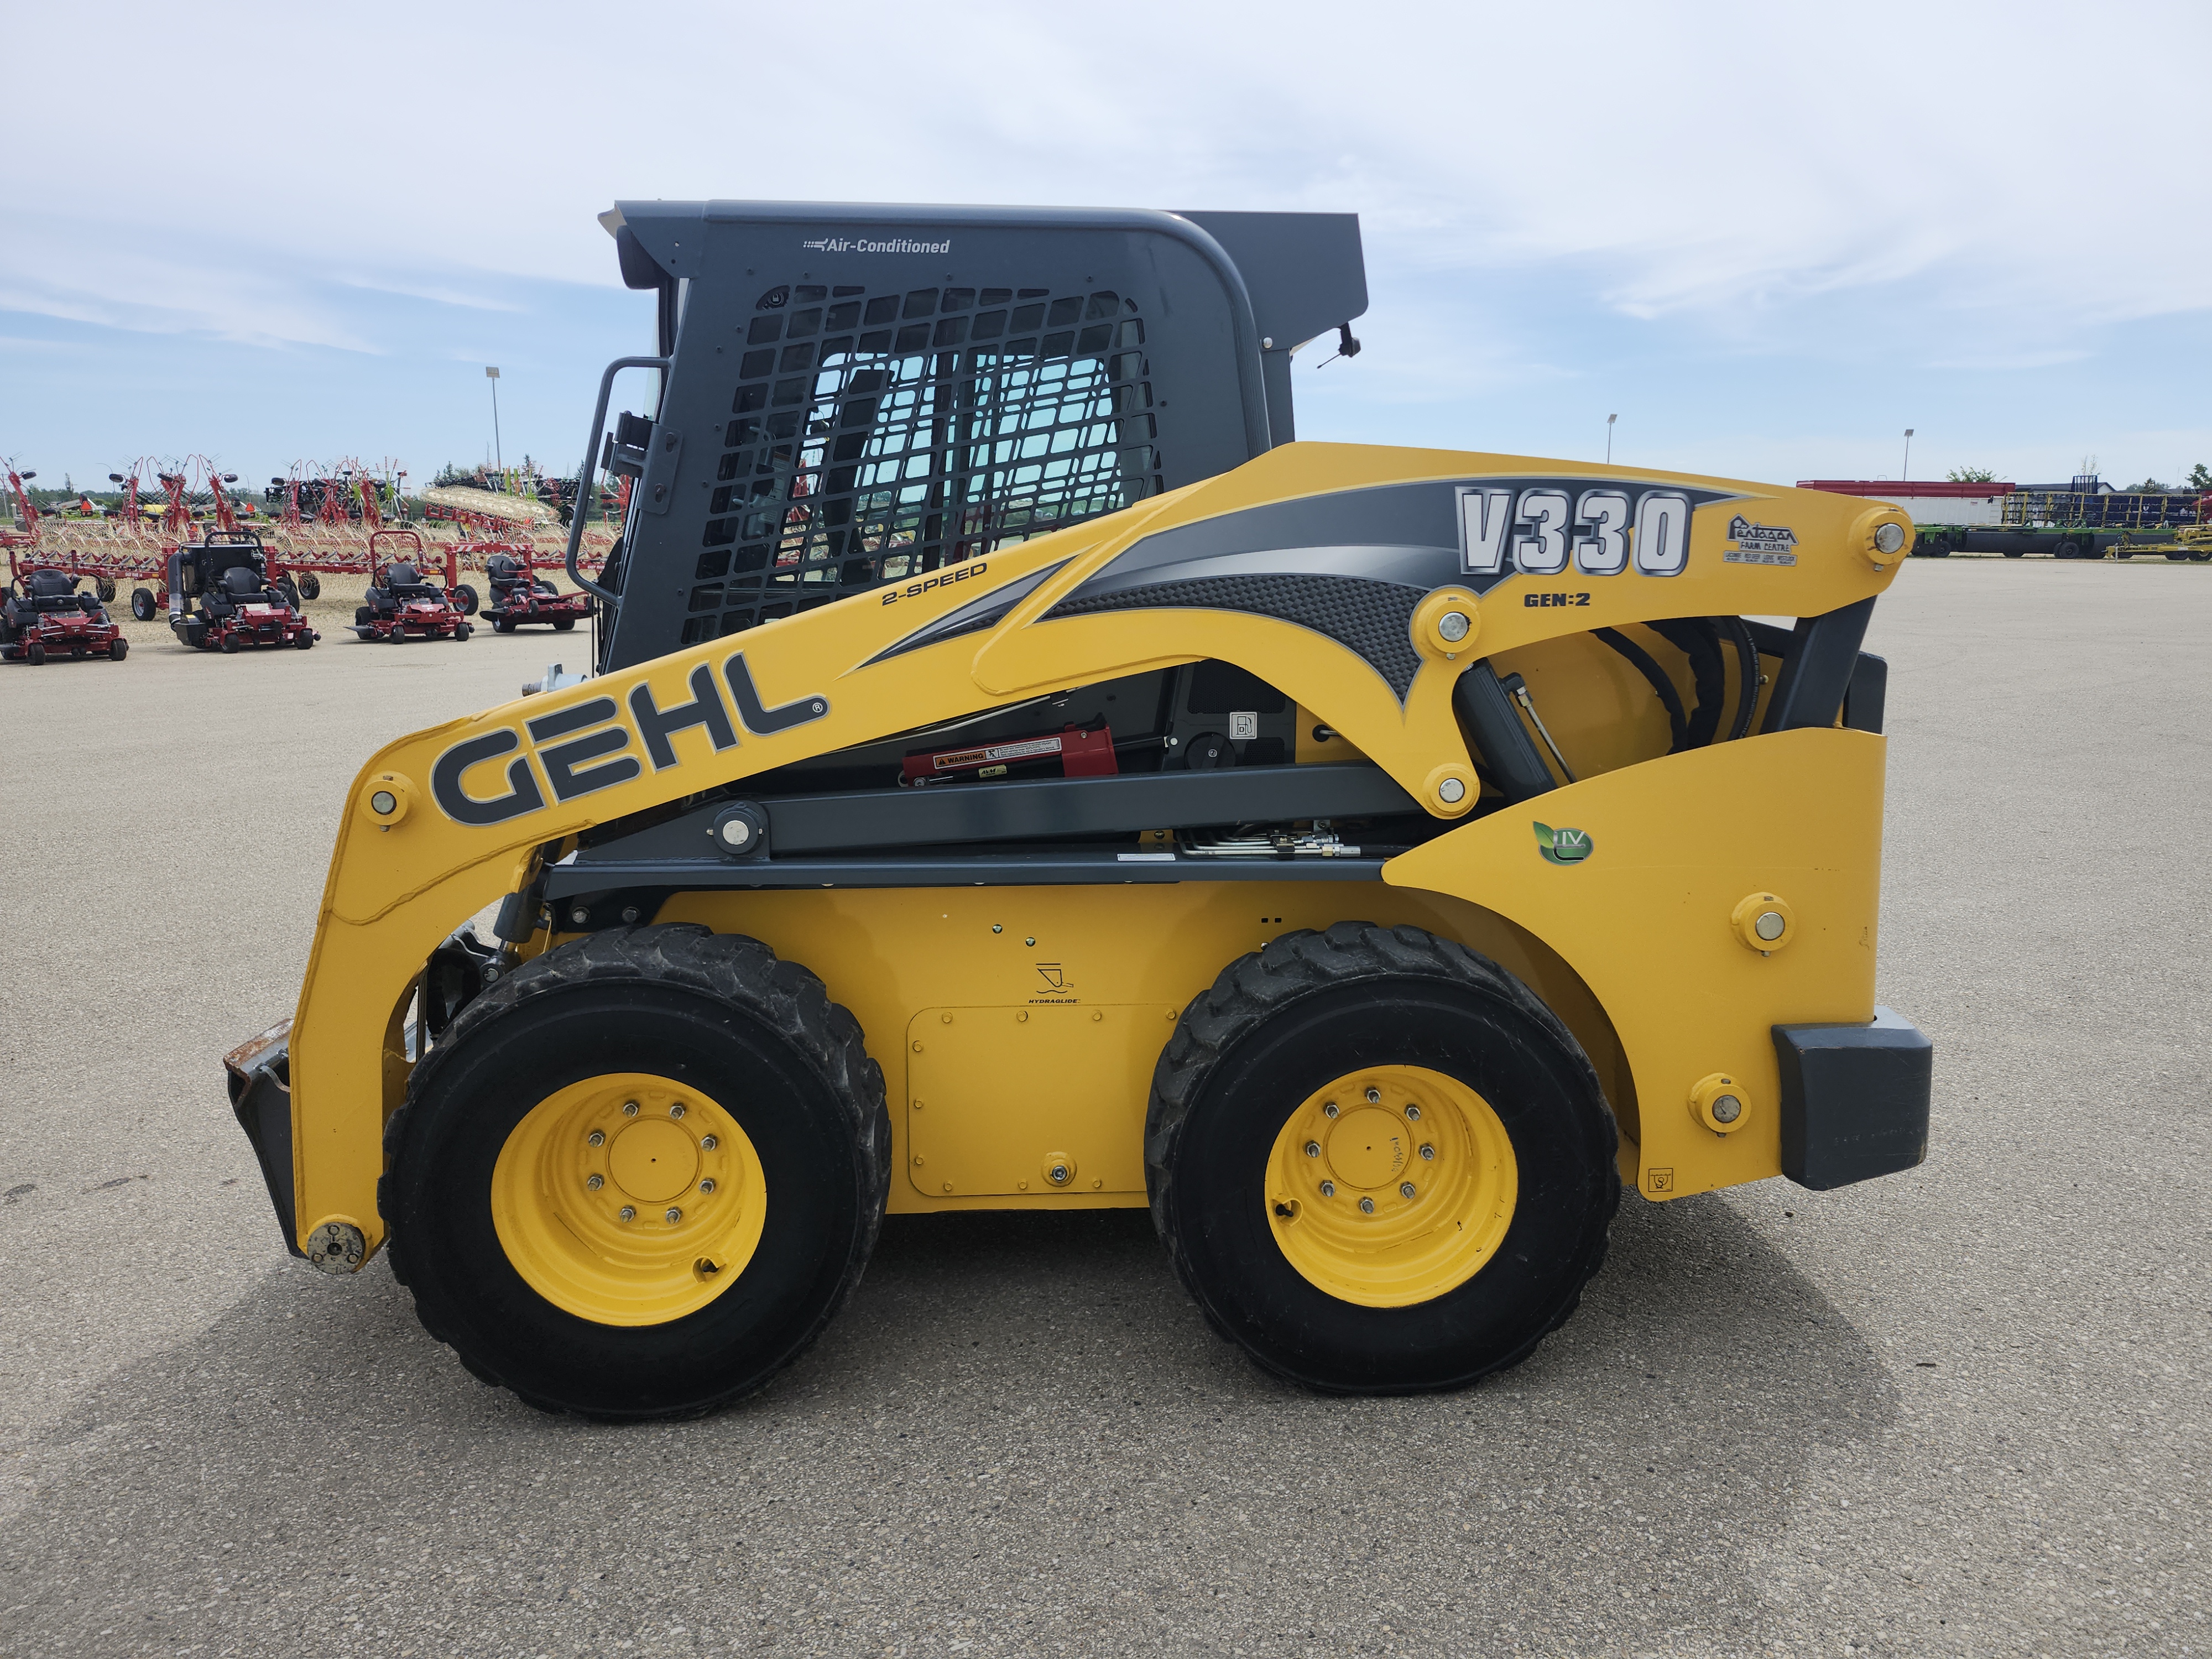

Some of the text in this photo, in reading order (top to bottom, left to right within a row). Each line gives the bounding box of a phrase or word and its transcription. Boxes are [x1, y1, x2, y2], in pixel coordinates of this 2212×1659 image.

[826, 238, 951, 254] Air-Conditioned
[1455, 486, 1691, 577] V330
[1740, 541, 1790, 552] FARM CENTRE
[881, 562, 987, 606] 2-SPEED
[1524, 592, 1590, 607] GEN:2
[431, 650, 830, 827] GEHL
[947, 753, 984, 763] WARNING
